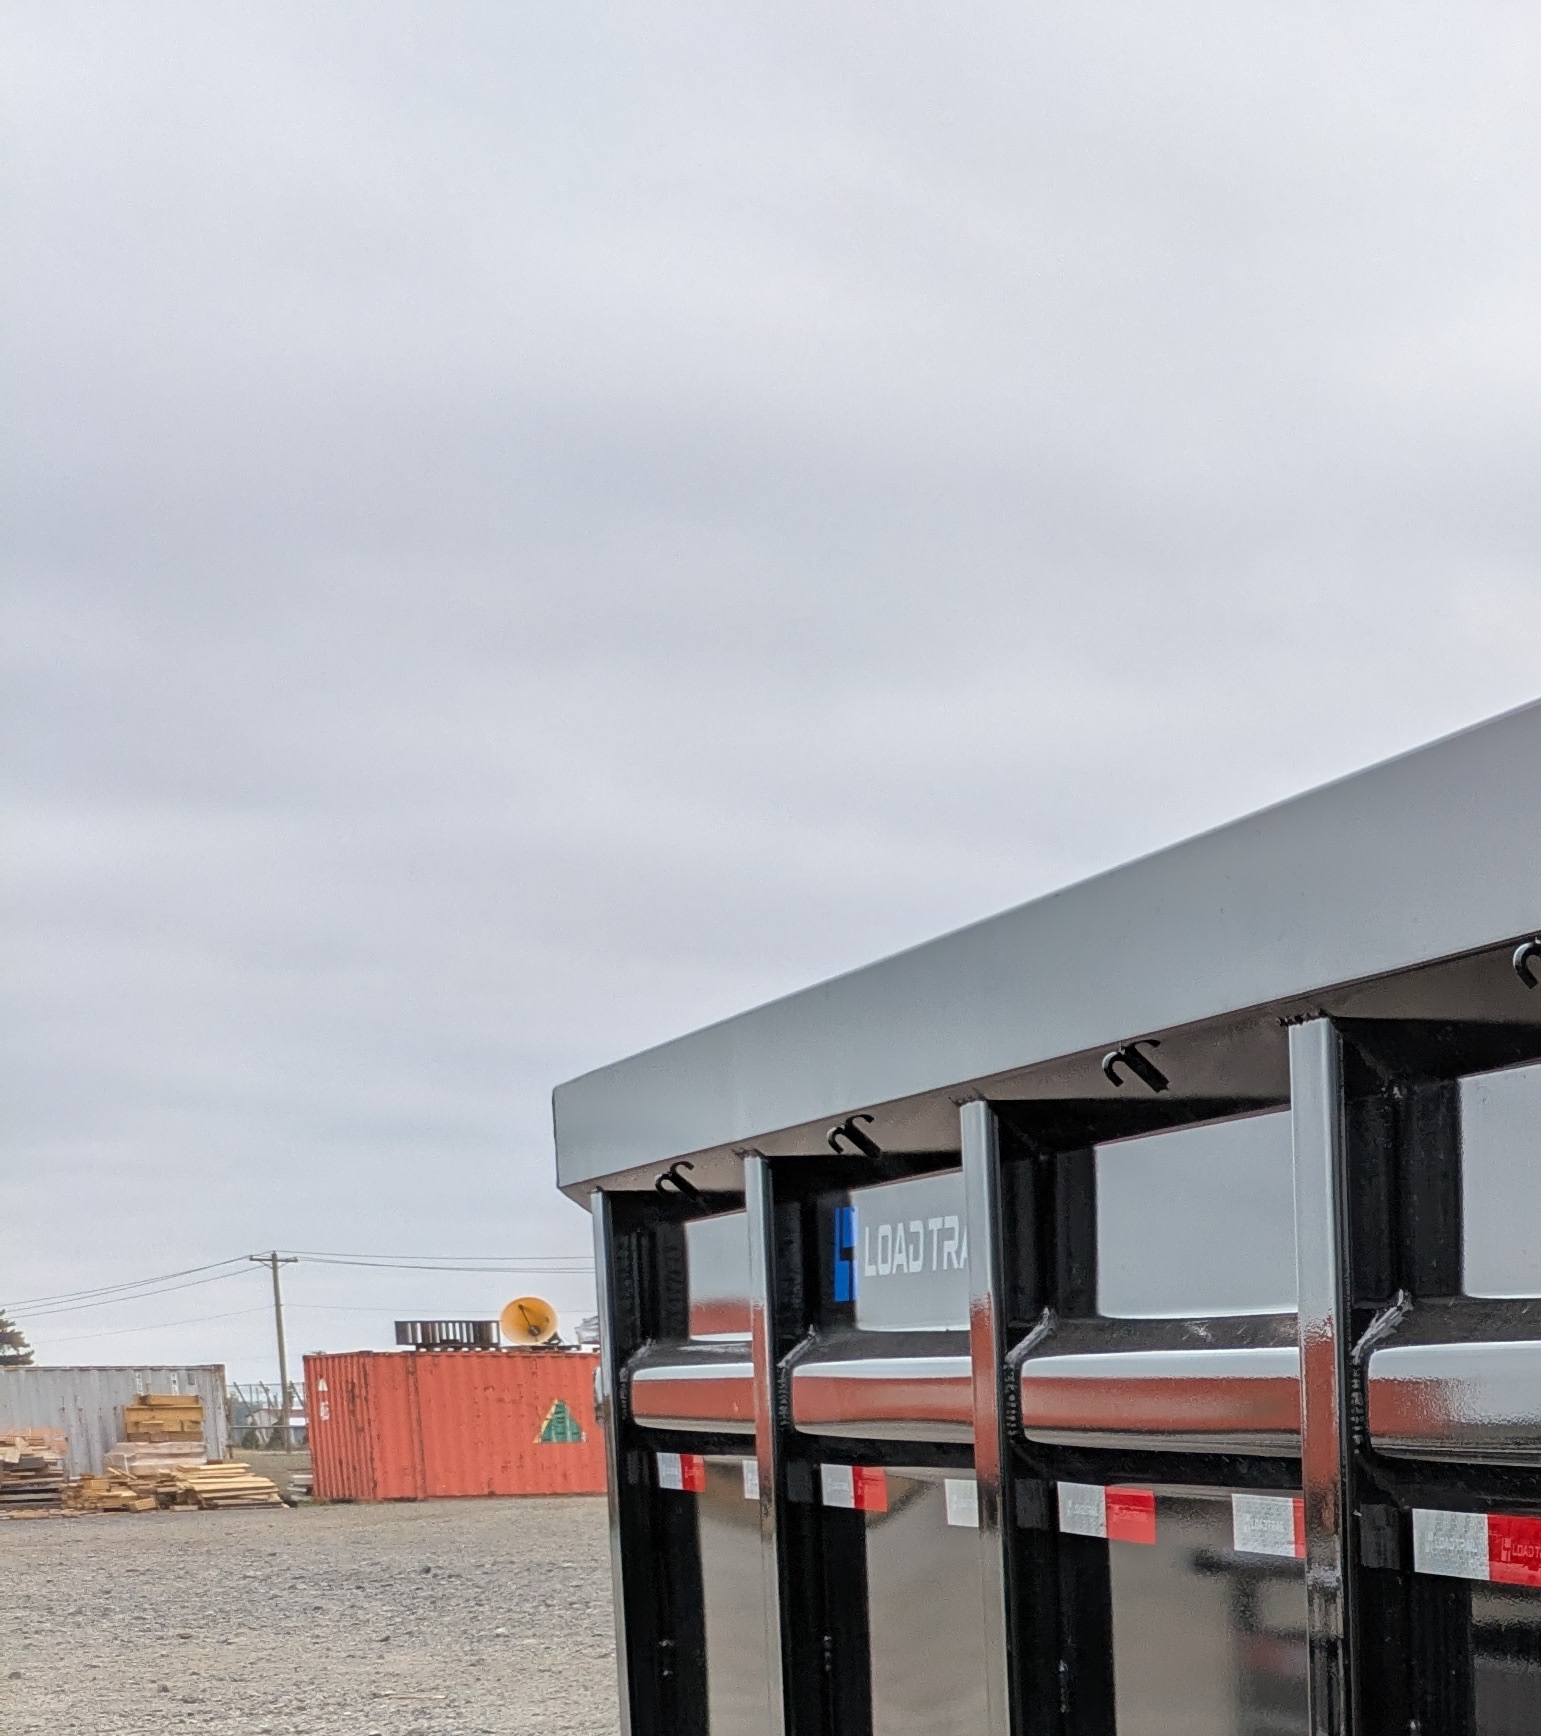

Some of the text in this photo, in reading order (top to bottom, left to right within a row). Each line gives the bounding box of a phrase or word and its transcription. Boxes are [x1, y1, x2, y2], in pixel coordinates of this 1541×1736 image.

[863, 1215, 969, 1278] LOAD TRA
[1512, 1543, 1534, 1558] LOAD
